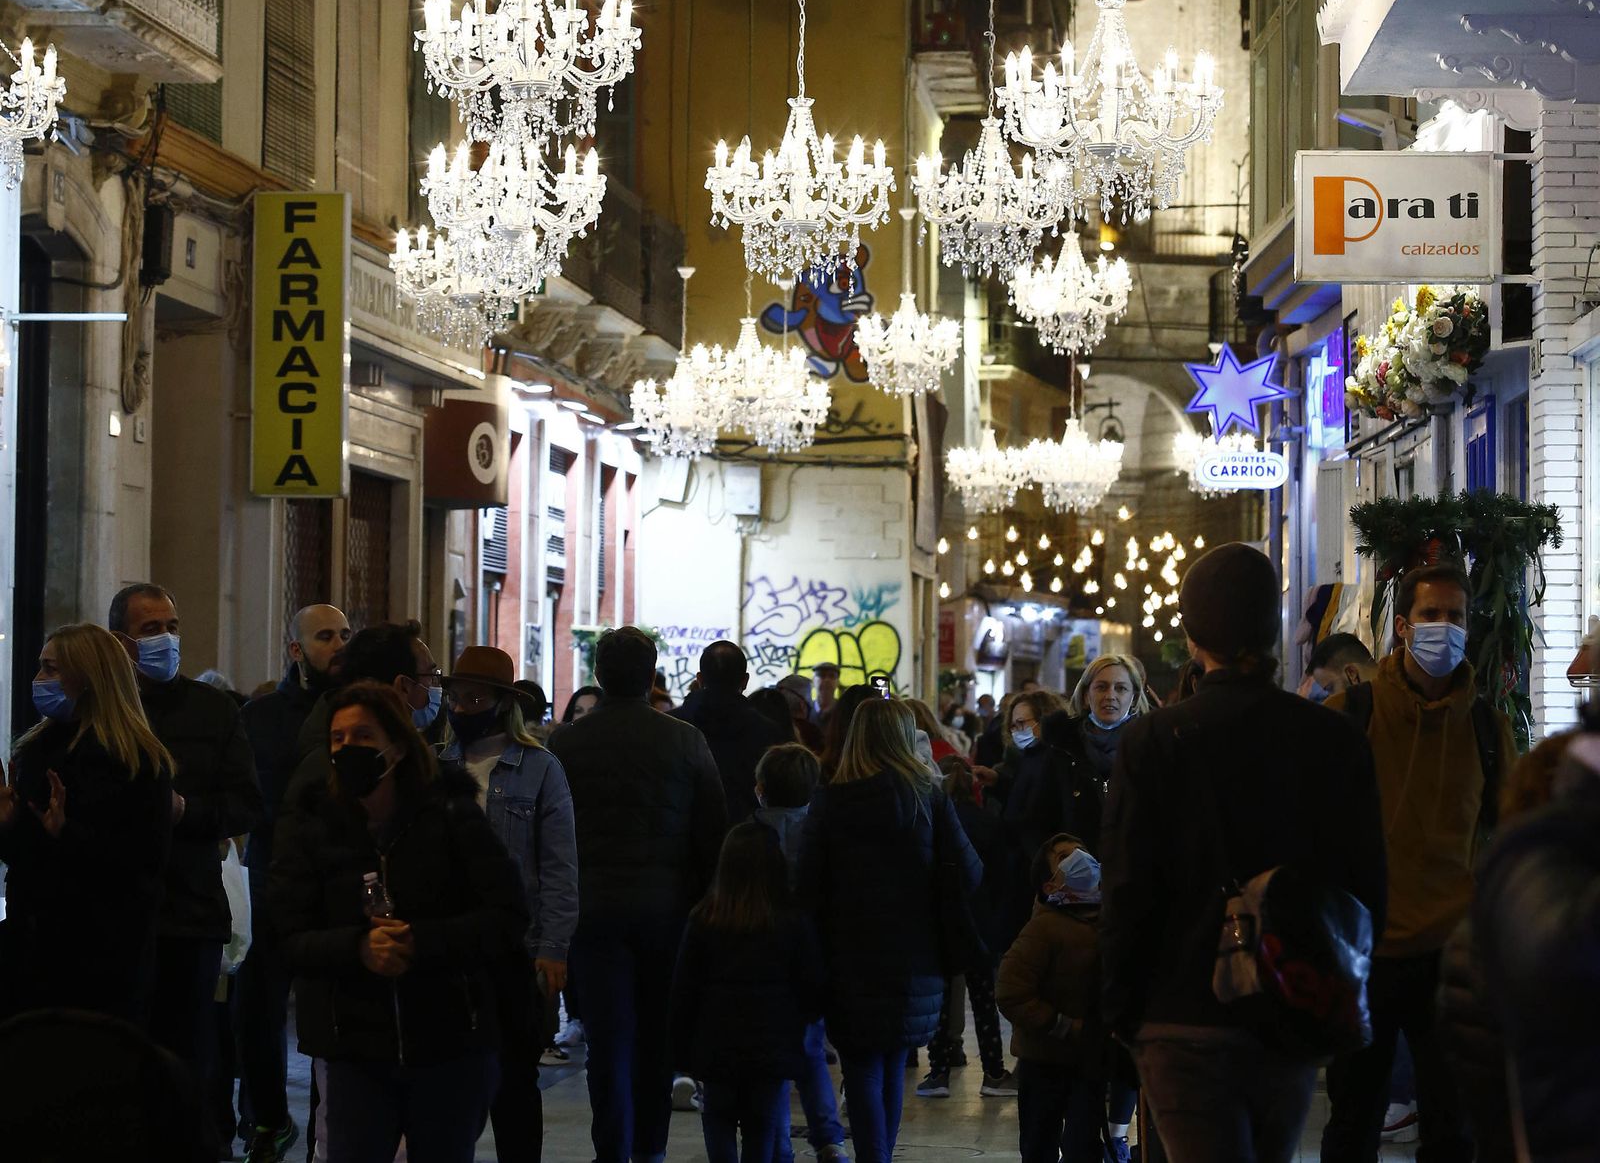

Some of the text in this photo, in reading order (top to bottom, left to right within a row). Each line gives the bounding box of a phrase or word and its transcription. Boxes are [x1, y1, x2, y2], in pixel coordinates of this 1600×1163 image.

[1314, 177, 1479, 255] Para ti
[1401, 242, 1480, 256] calzados
[272, 202, 325, 486] FARMACIA
[1210, 465, 1276, 477] CARRION
